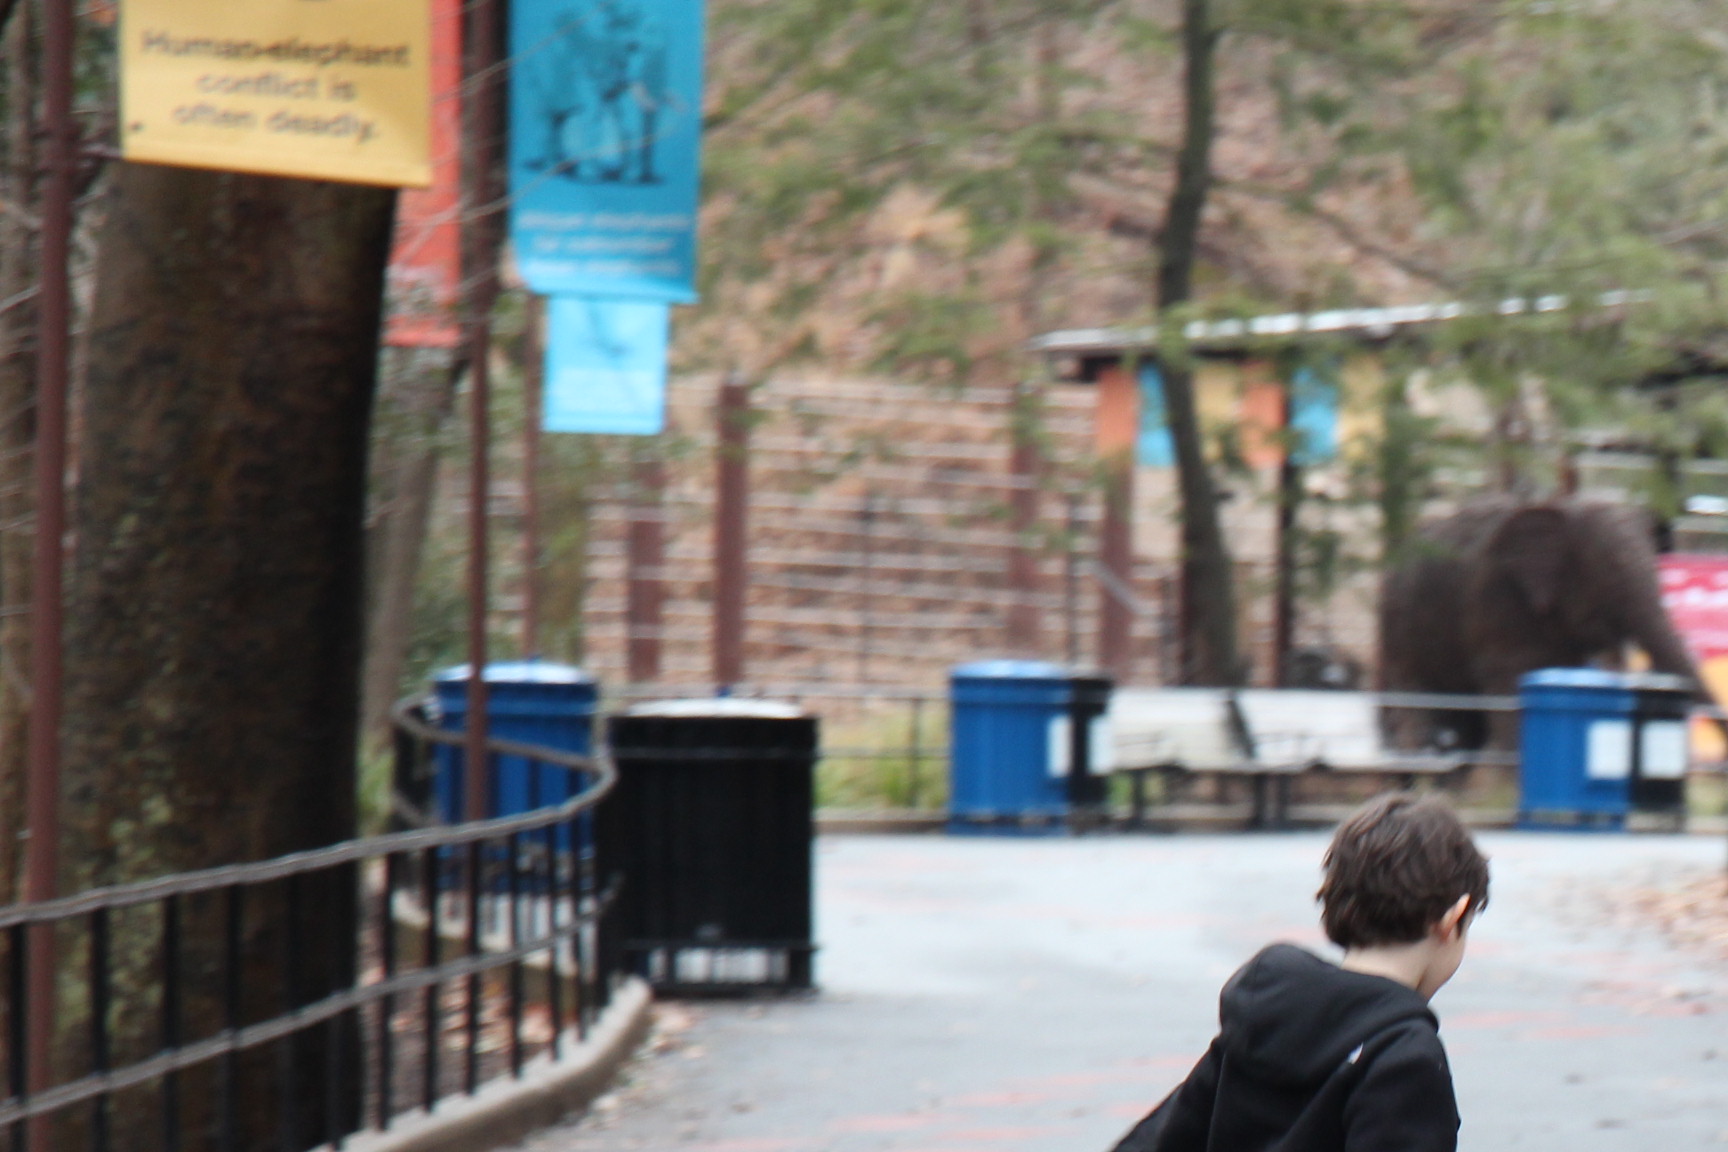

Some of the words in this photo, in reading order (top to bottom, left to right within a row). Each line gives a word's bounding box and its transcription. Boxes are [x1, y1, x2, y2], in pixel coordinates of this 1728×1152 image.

[141, 29, 410, 68] Human-elephant
[195, 72, 318, 99] conflict
[328, 75, 356, 101] is
[171, 102, 257, 128] often
